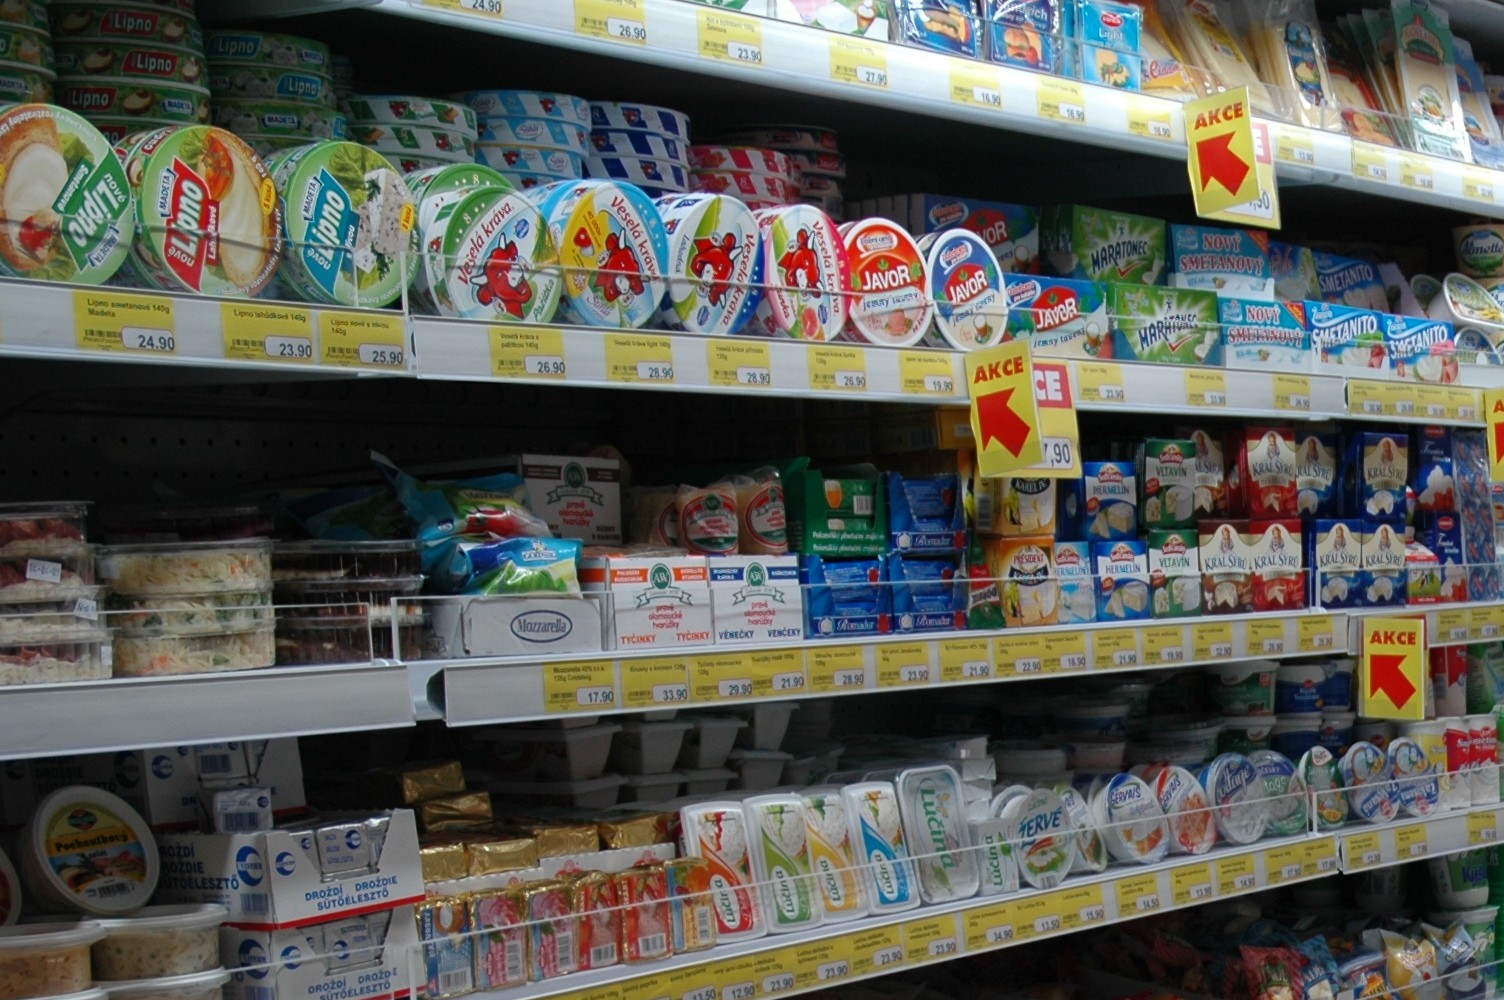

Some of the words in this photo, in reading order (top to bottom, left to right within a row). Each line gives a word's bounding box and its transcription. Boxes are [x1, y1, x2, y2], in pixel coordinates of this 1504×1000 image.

[473, 0, 501, 13] 24.90
[113, 17, 152, 36] Lipno
[619, 24, 647, 39] 26.90
[217, 37, 256, 54] Lipno
[738, 47, 762, 62] 23.90
[136, 53, 173, 72] Lipno
[865, 70, 888, 85] 27.90
[288, 81, 317, 97] Lipno
[72, 90, 109, 110] Lipno
[1194, 103, 1244, 130] AKCE
[159, 175, 172, 214] MADETA
[302, 181, 319, 222] MADETA
[68, 183, 121, 248] Lipno
[171, 180, 204, 253] Lipno
[317, 189, 346, 258] Lipno
[610, 195, 639, 242] Veselá
[457, 230, 488, 286] Veselá
[482, 200, 515, 236] kráva
[812, 219, 833, 270] Veselá
[1203, 228, 1242, 249] NOVÝ
[168, 245, 195, 268] nové
[307, 246, 332, 271] nové
[738, 232, 756, 282] Veselá
[1090, 238, 1147, 271] MARATONEC
[1180, 254, 1265, 275] SMETANOVÝ
[861, 264, 911, 290] JAVOR
[1320, 266, 1374, 291] SMETANITO
[949, 271, 988, 303] JAVOR
[88, 299, 110, 310] Lipno
[1246, 304, 1281, 324] NOVÝ
[1036, 301, 1078, 330] JAVOR
[1312, 317, 1378, 348] SMETANITO
[138, 334, 175, 351] 24.90
[280, 342, 313, 358] 23.90
[1389, 327, 1449, 358] SMETANITO
[373, 350, 404, 365] 25.90
[538, 361, 566, 375] 26.90
[648, 366, 674, 380] 28.90
[973, 357, 1025, 384] AKCE
[747, 372, 771, 385] 28.90
[844, 374, 866, 387] 26.90
[933, 380, 953, 393] 19.90
[1253, 555, 1278, 571] KRÁL
[515, 617, 569, 636] Mozzarella
[676, 630, 710, 642] TYČINKY
[620, 632, 657, 645] TYČINKY
[1369, 631, 1417, 646] AKCE
[907, 669, 929, 682] 23.90
[969, 665, 990, 677] 21.90
[1022, 661, 1042, 672] 22.90
[781, 676, 805, 689] 21.90
[842, 672, 865, 686] 28.90
[588, 690, 614, 704] 17.90
[662, 688, 688, 701] 33.90
[728, 683, 752, 696] 29.90
[920, 788, 955, 870] Lučina
[55, 831, 130, 854] Pochoutkový
[985, 835, 1002, 887] Lučina
[821, 859, 840, 903] Lučina
[874, 851, 894, 896] Lučina
[304, 886, 344, 902] DROŽDÍ
[354, 875, 398, 892] DROŽDIE
[775, 869, 795, 915] Lučina
[716, 878, 737, 924] Lučina
[880, 950, 903, 965] 23.90
[935, 942, 957, 955] 23.90
[825, 965, 849, 979] 23.90
[308, 979, 347, 995] DROŽDÍ
[770, 978, 794, 992] 23.90
